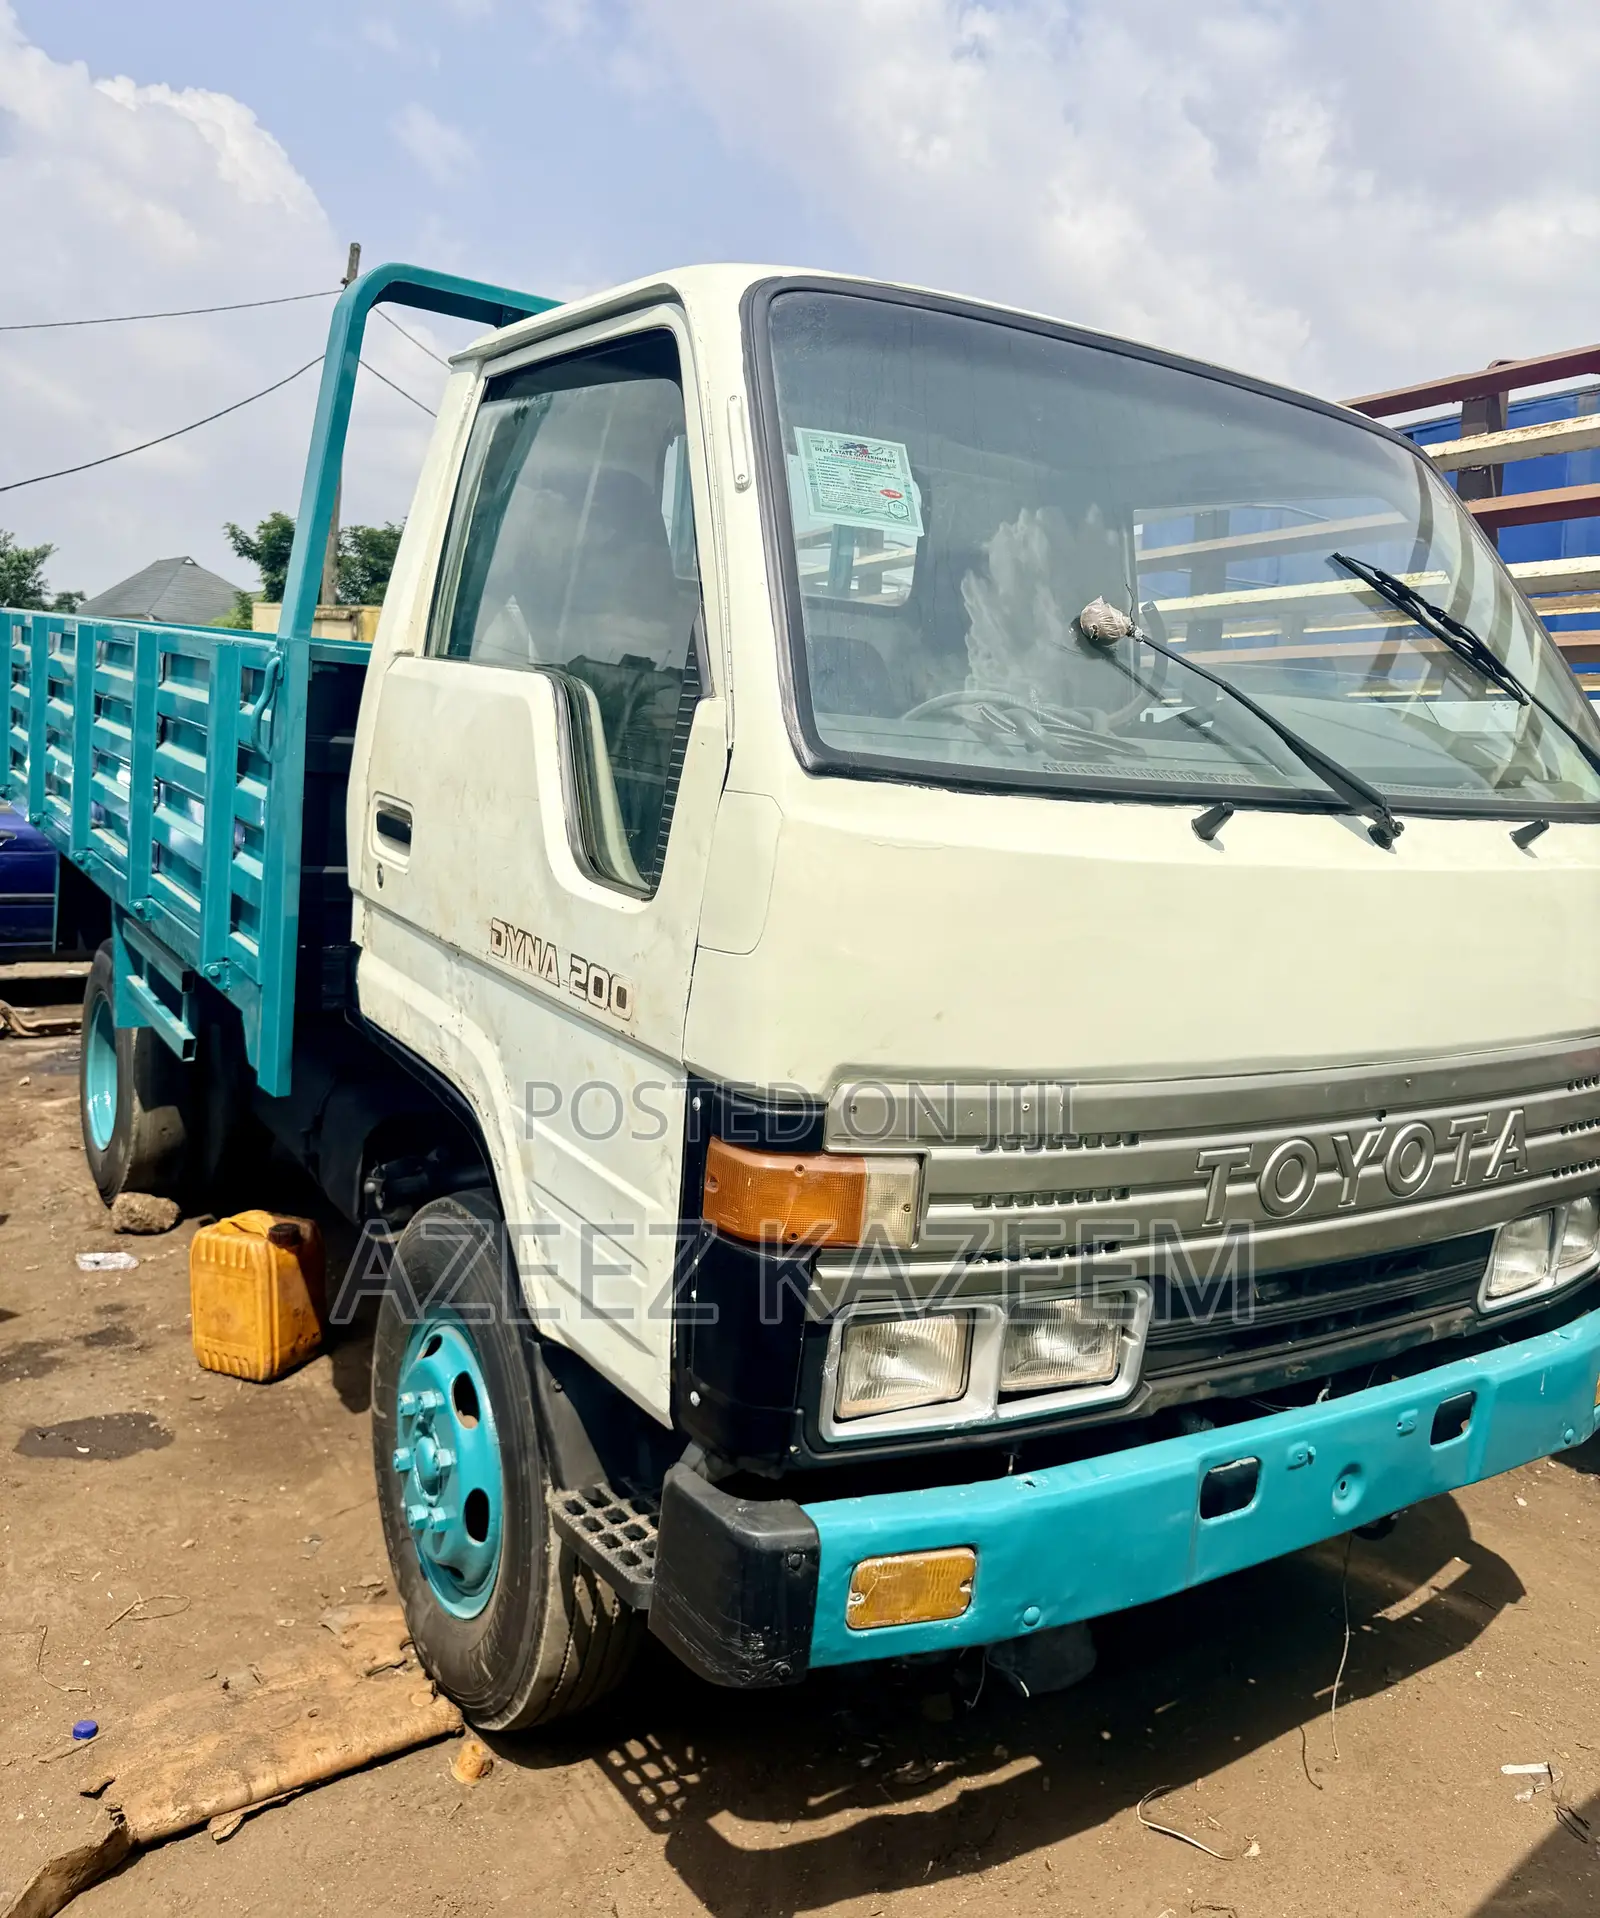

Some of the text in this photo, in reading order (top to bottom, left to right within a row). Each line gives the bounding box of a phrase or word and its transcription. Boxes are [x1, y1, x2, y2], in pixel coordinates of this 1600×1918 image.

[815, 446, 833, 454] DELTA
[491, 917, 633, 1021] DYNA 200
[1194, 1107, 1529, 1227] TOYOTA
